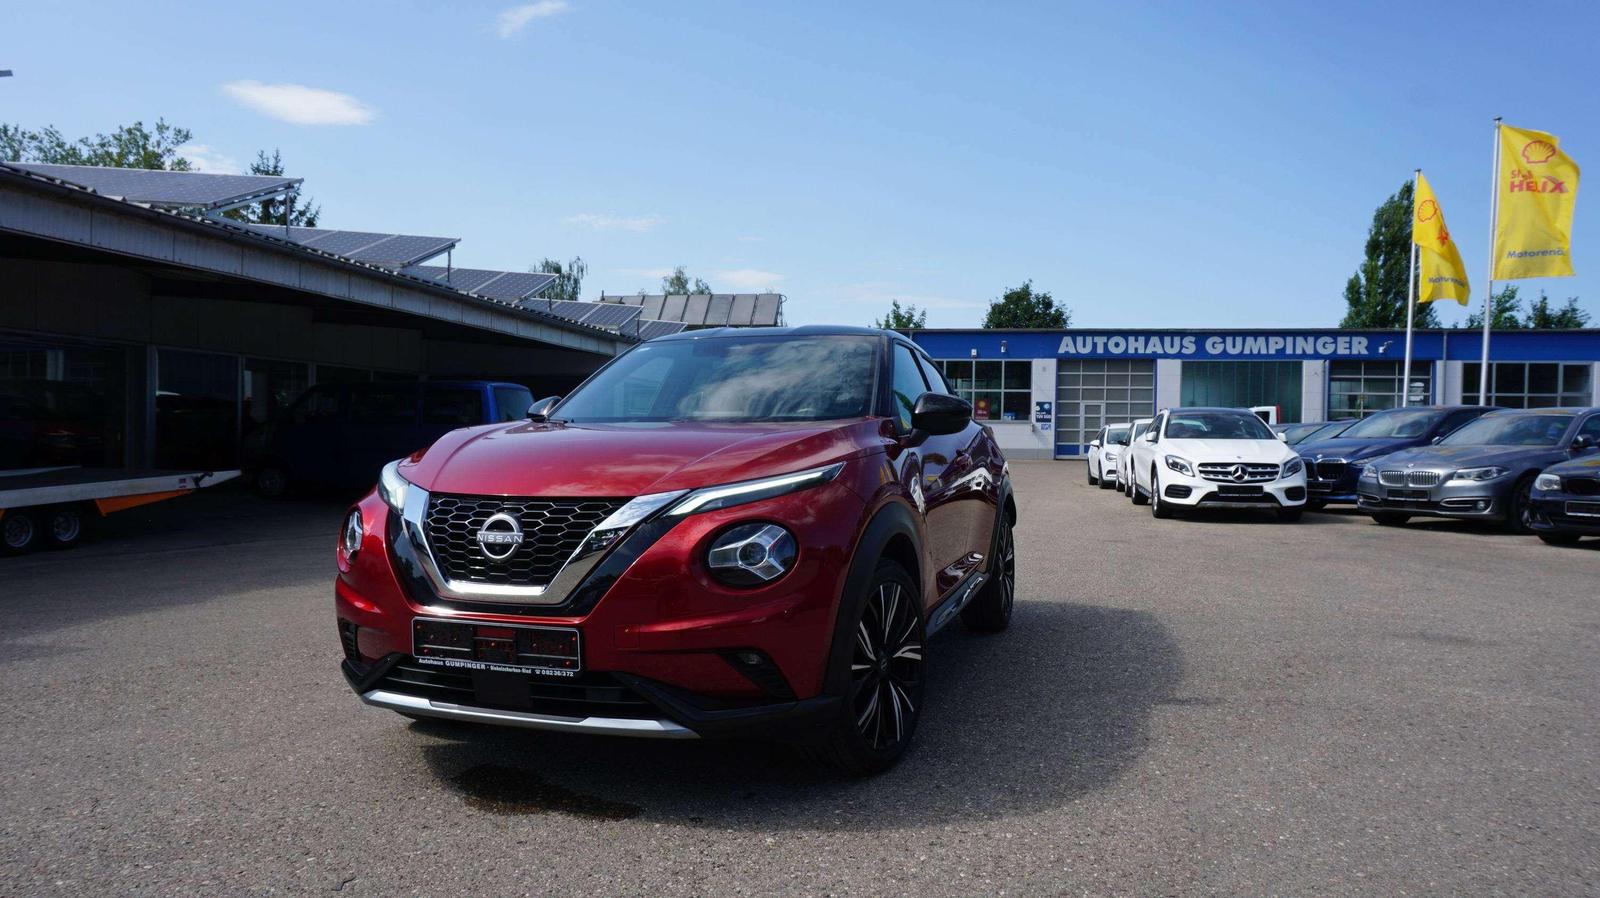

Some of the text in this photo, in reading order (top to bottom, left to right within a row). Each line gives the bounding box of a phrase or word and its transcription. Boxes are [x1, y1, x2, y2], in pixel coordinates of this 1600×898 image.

[1057, 336, 1369, 354] AUTOHAUS GUMPINGER
[476, 533, 523, 543] NISSAN
[418, 658, 444, 666] Autohaus
[445, 660, 486, 670] GUMPINGER
